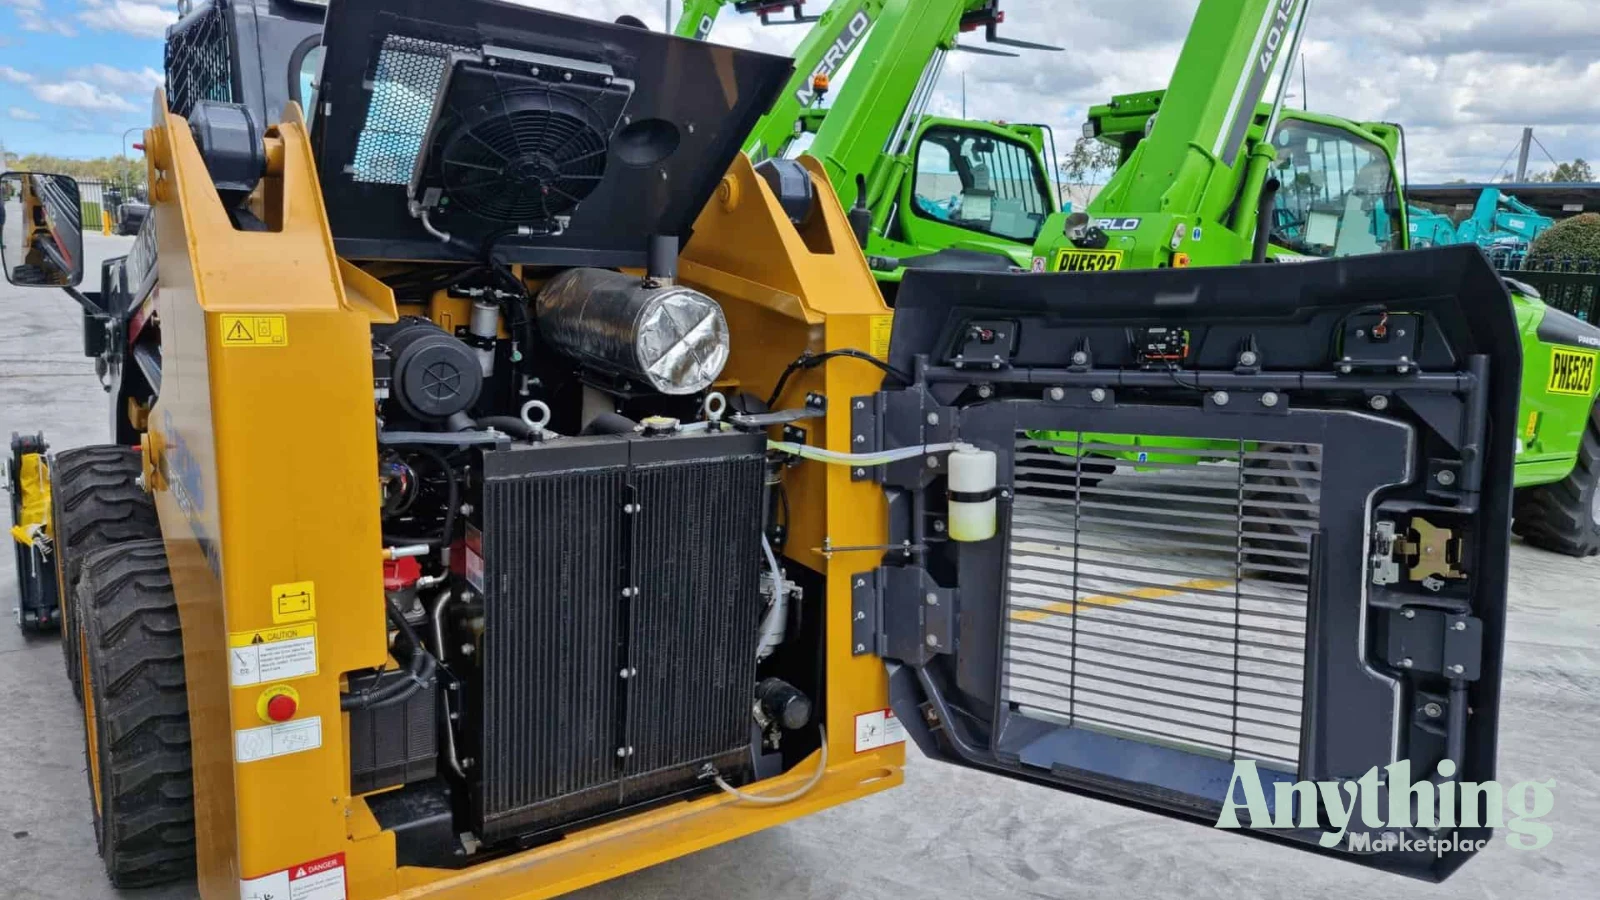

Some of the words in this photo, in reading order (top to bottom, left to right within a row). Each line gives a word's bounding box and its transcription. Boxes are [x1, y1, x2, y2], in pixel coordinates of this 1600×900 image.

[1578, 335, 1600, 346] PANOR
[1551, 353, 1594, 392] PHE523
[267, 630, 298, 641] CAUTION
[307, 859, 338, 874] DANGER
